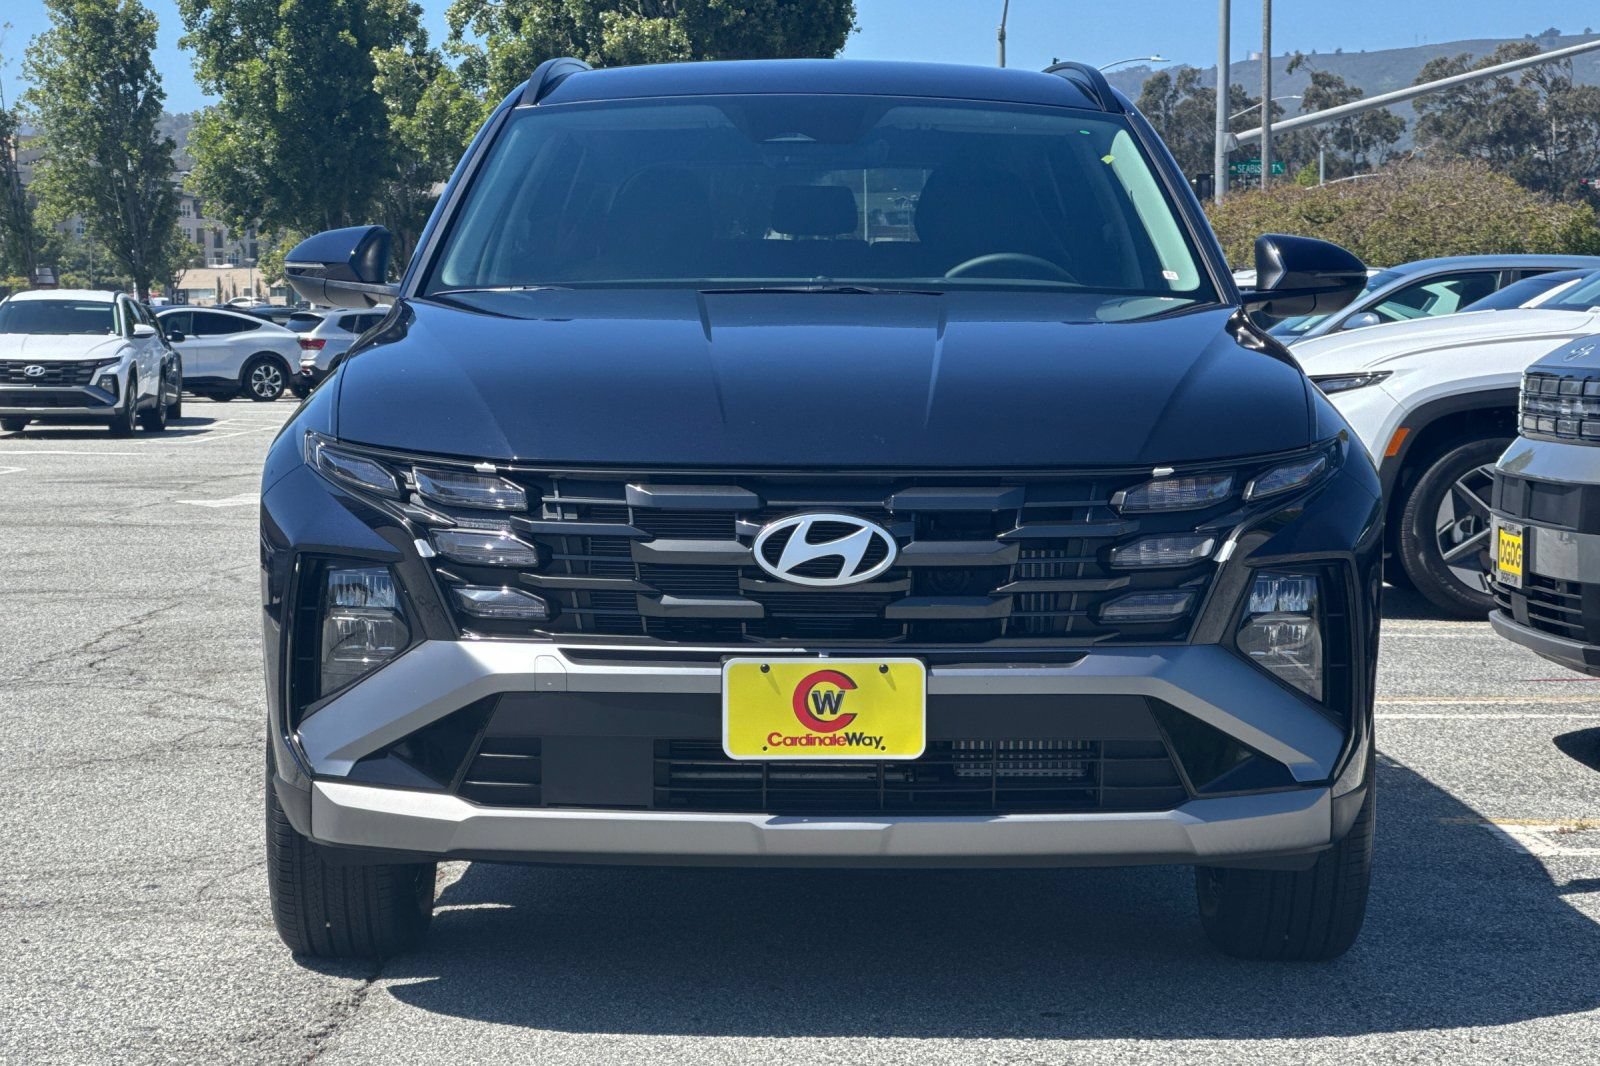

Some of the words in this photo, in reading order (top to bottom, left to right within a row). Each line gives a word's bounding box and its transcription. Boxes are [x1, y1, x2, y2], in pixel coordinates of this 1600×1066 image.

[172, 292, 185, 304] 15
[1501, 539, 1522, 568] DGDG
[767, 731, 883, 749] CardinaleWay
